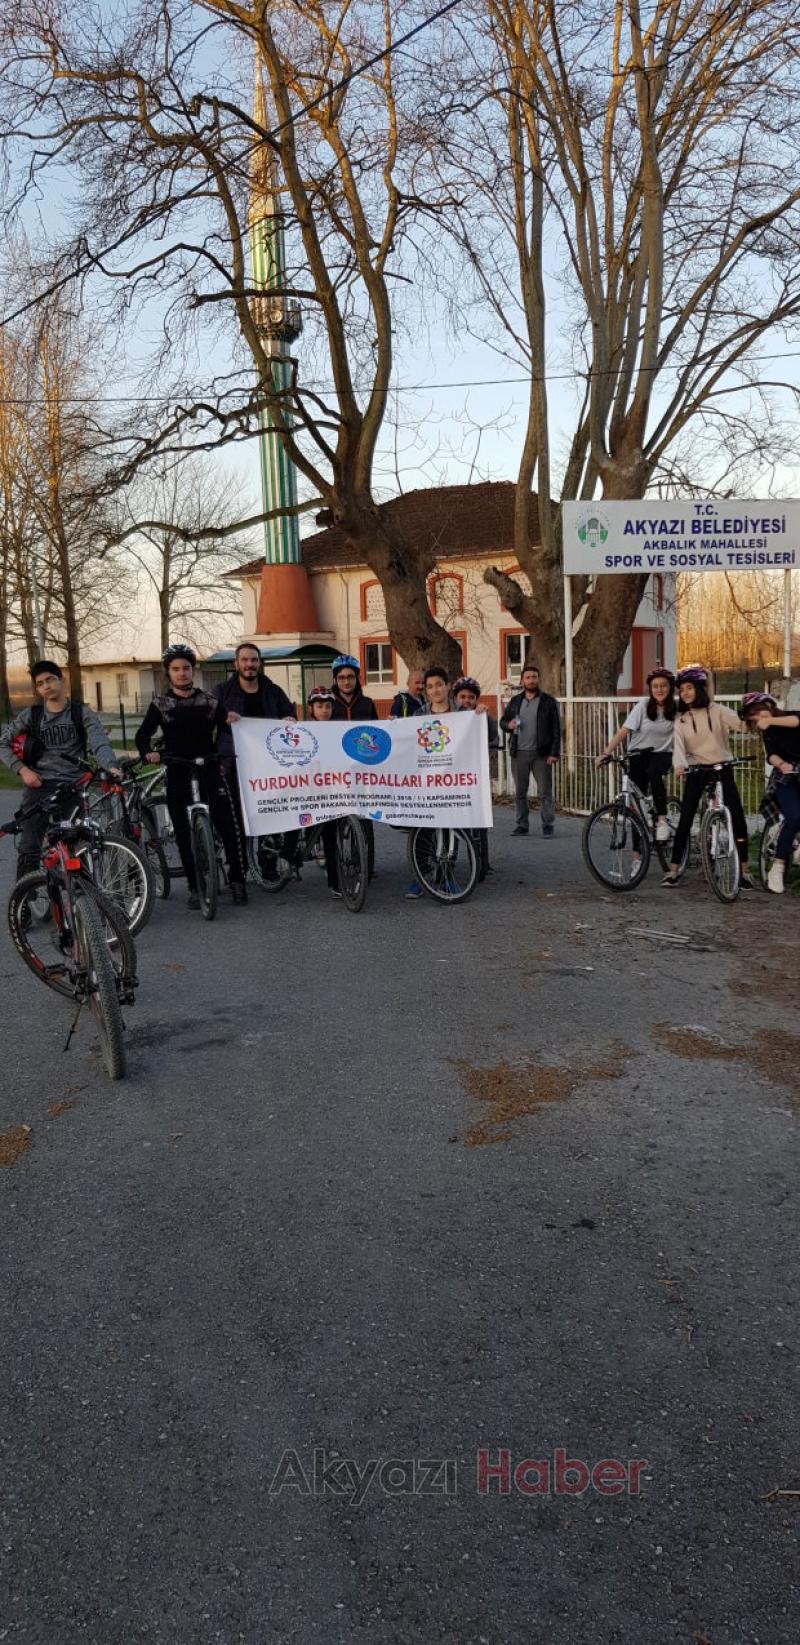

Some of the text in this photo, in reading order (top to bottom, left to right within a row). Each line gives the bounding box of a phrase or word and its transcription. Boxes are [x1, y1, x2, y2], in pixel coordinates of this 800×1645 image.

[694, 505, 719, 516] T.C.
[623, 519, 685, 535] AKYAZI
[691, 515, 786, 534] BELEDİYESİ
[643, 537, 767, 550] AKBALIK MAHALLESİ
[604, 550, 796, 568] SPOR VE SOSYAL TESİSLERİ
[249, 774, 308, 792] YURDUN
[313, 772, 352, 789] GENÇ
[355, 773, 422, 787] PEDALLARI
[300, 803, 319, 811] SPOR
